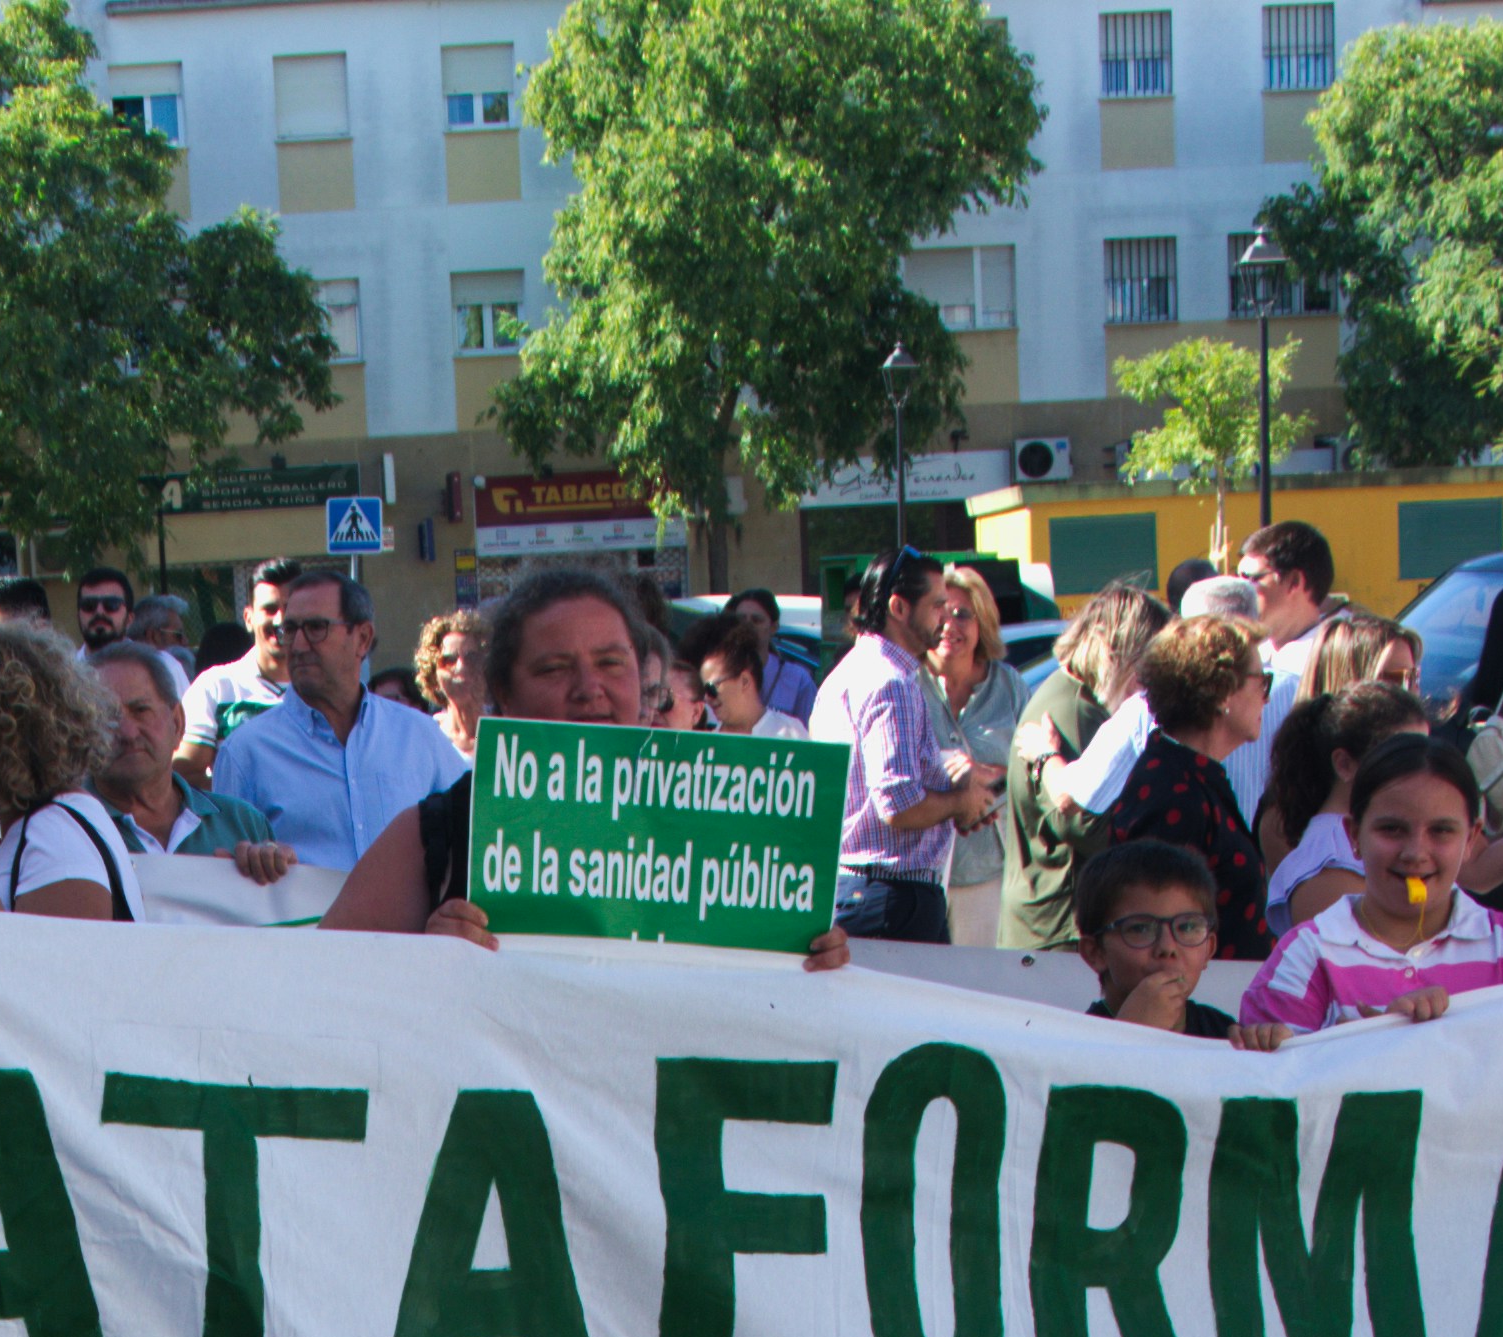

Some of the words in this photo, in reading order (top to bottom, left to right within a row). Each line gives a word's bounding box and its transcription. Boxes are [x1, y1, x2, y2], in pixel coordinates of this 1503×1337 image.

[262, 480, 347, 493] CABALLERO
[493, 733, 539, 800] No
[546, 752, 566, 801] a
[575, 738, 603, 803] la
[611, 743, 816, 821] privatización
[482, 828, 523, 893] de
[531, 830, 559, 895] la
[567, 835, 693, 904] sanidad
[698, 842, 815, 922] pública
